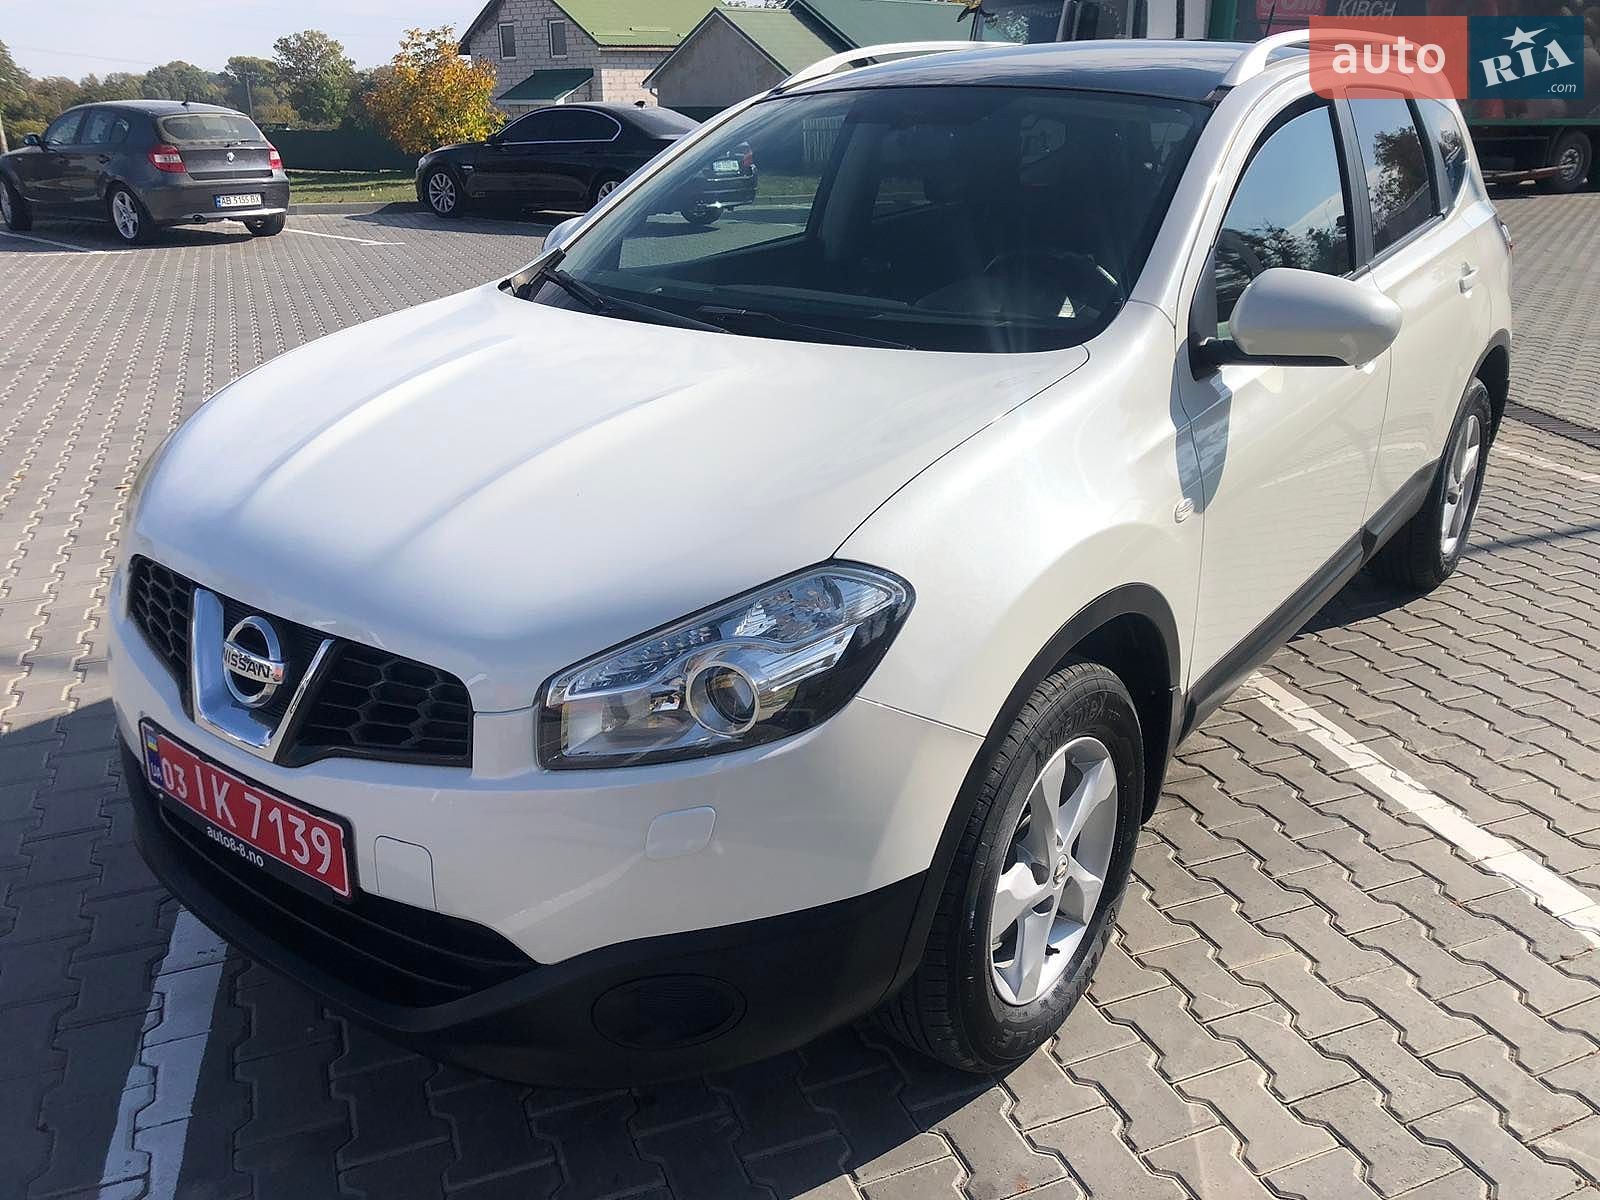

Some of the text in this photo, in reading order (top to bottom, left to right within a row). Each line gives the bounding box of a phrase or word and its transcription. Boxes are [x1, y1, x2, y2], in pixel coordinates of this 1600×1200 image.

[221, 196, 232, 205] AB
[223, 647, 272, 678] NISSAN
[161, 757, 332, 875] 03 IK 7139
[206, 825, 264, 868] auto8-8.no
